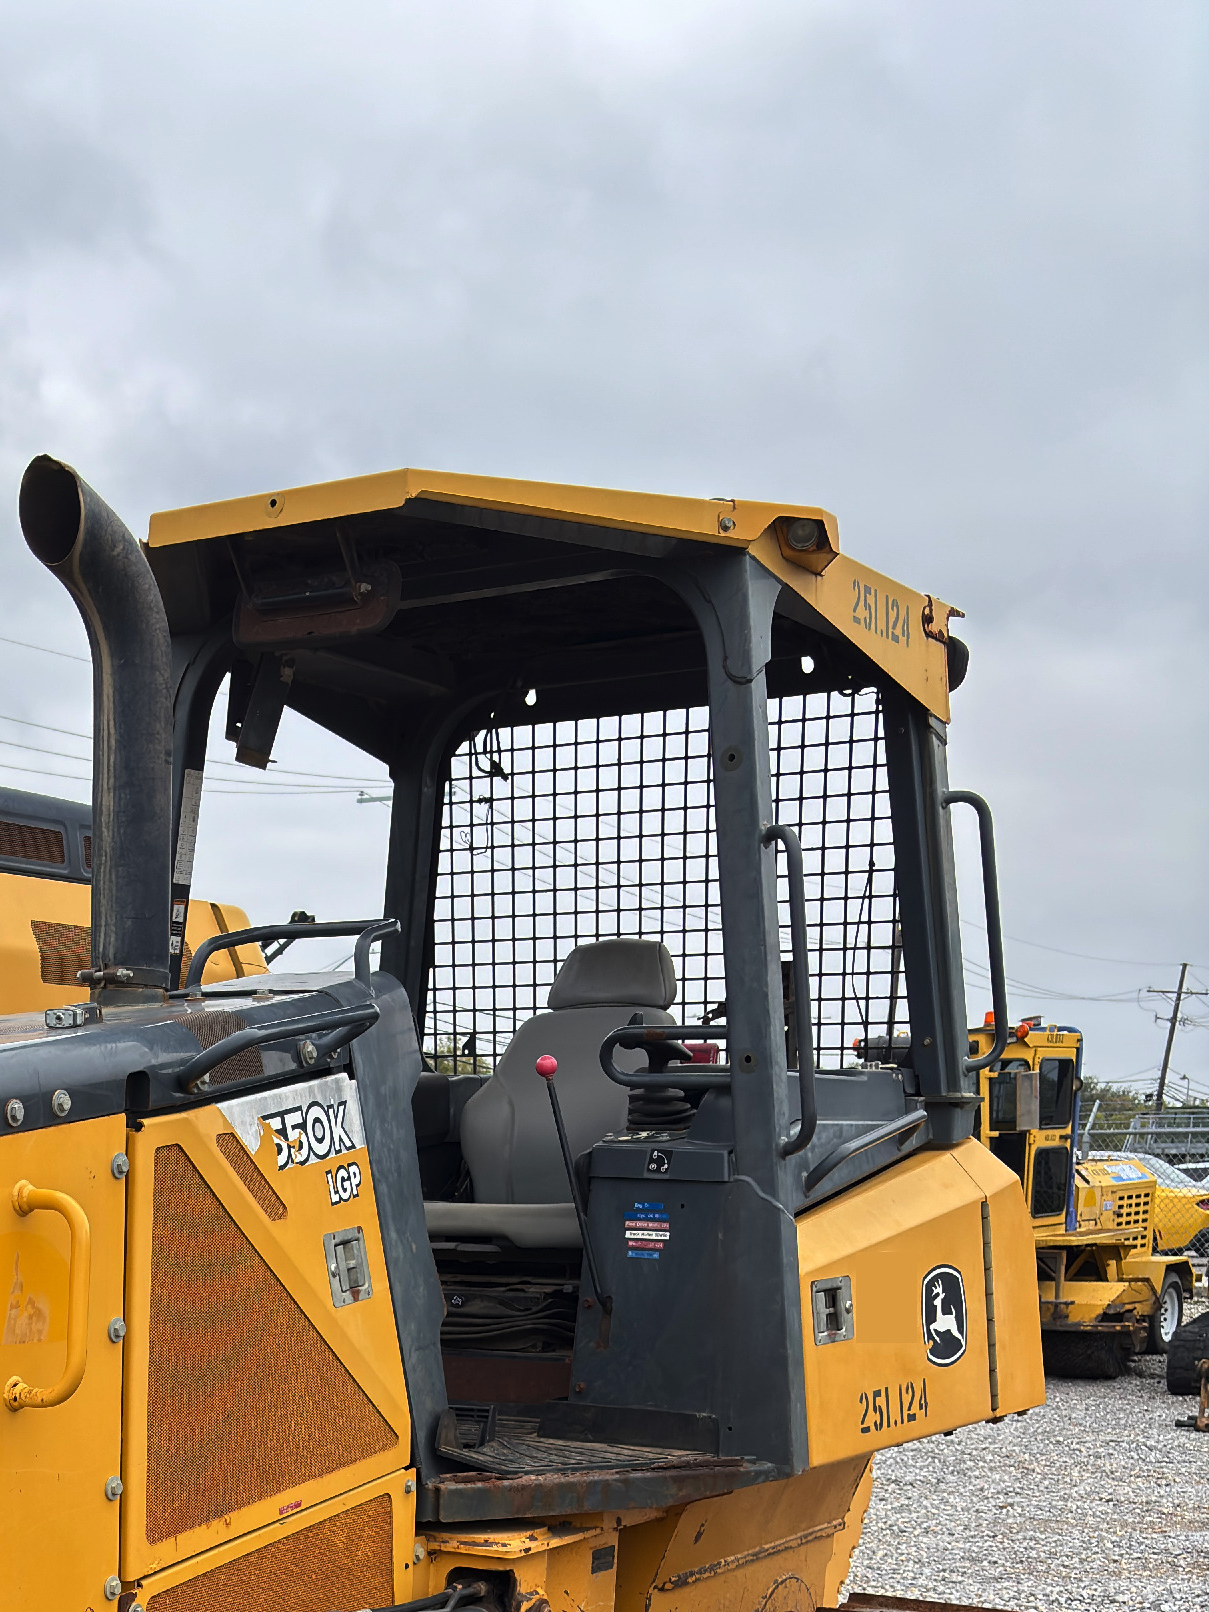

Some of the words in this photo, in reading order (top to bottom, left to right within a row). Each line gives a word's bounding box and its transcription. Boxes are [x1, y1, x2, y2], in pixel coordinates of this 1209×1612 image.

[852, 578, 911, 649] 251.124
[325, 1161, 362, 1207] LGP
[858, 1377, 929, 1435] 251.124
